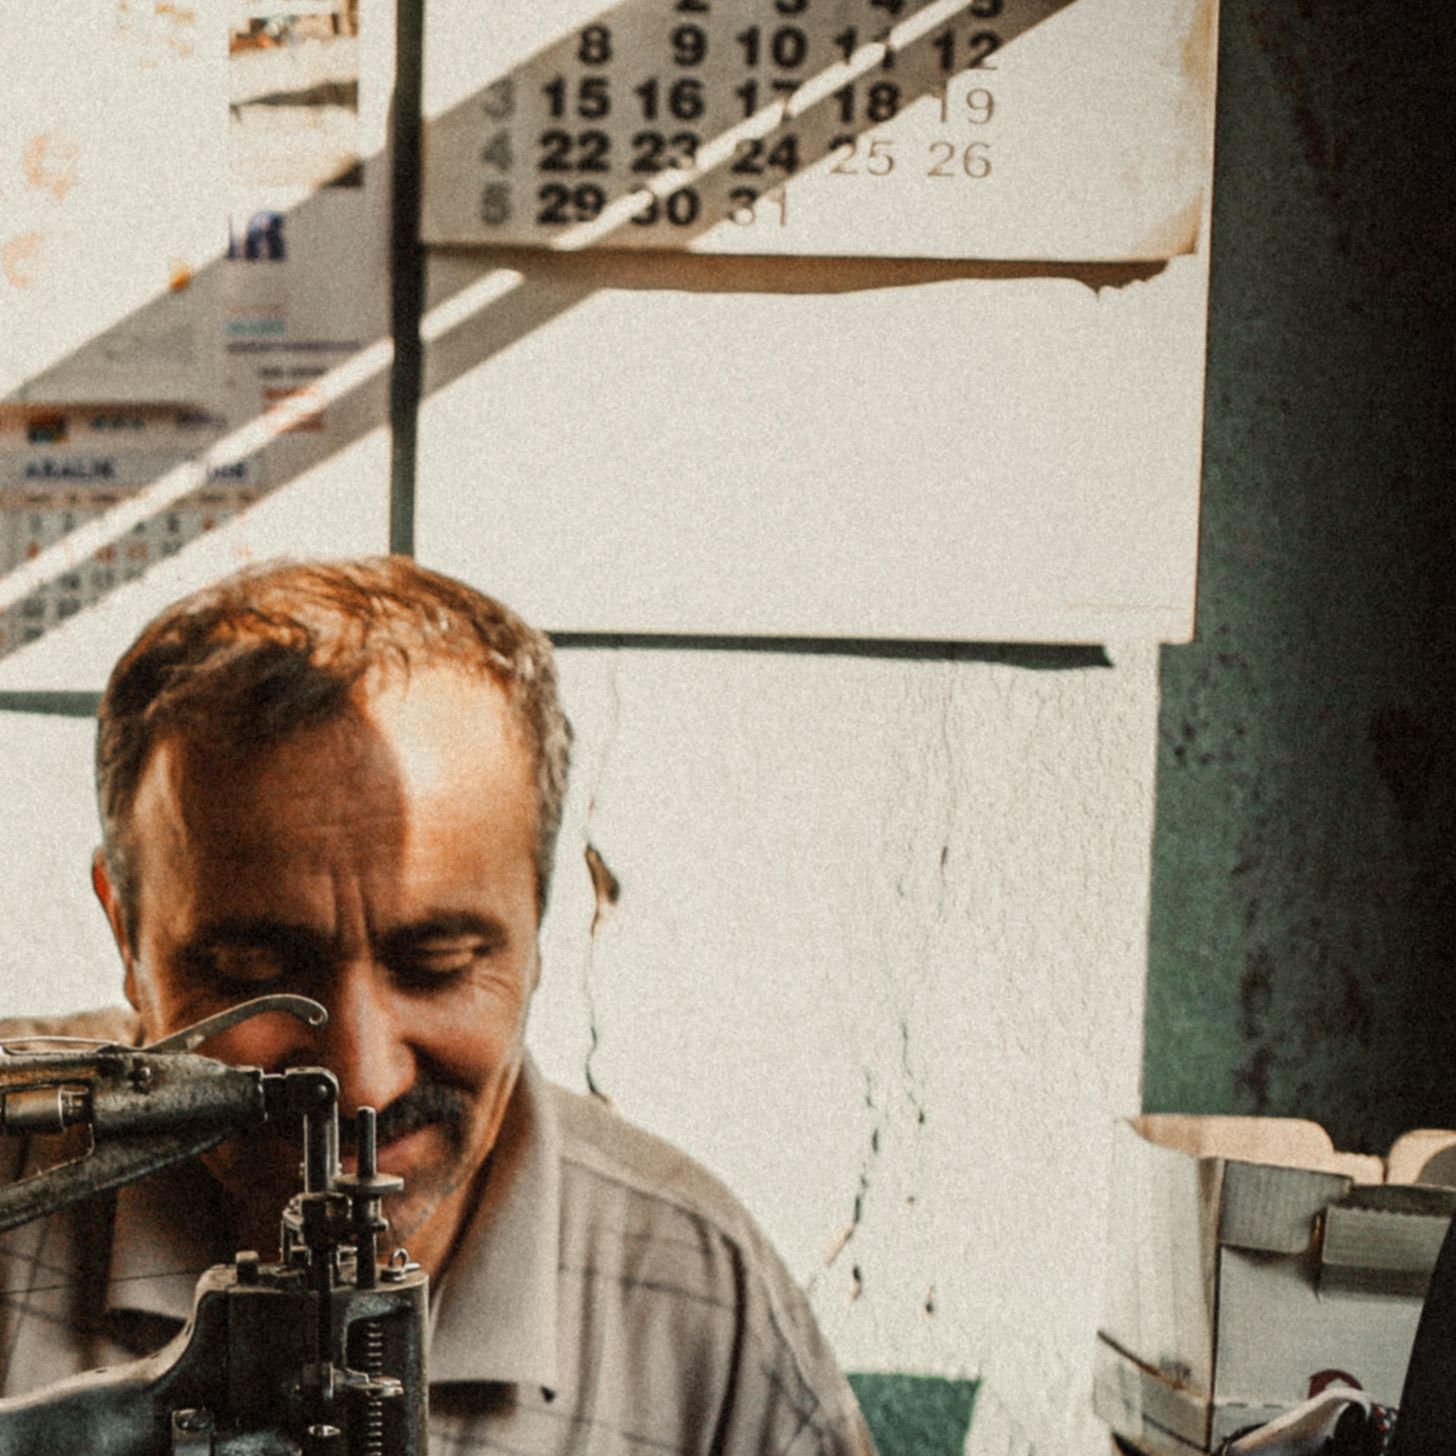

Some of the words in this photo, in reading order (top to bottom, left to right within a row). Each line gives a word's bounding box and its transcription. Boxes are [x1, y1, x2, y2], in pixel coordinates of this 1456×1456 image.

[577, 22, 613, 68] 8
[670, 22, 709, 68] 9
[735, 24, 808, 69] 10
[931, 27, 1003, 72] 12
[541, 75, 612, 121] 15
[633, 75, 706, 121] 16
[832, 80, 901, 125] 18
[931, 86, 996, 126] 19
[537, 129, 611, 173] 22
[729, 133, 800, 176] 24
[825, 134, 896, 177] 25
[926, 140, 993, 179] 26
[536, 182, 608, 226] 29
[727, 184, 788, 228] 31
